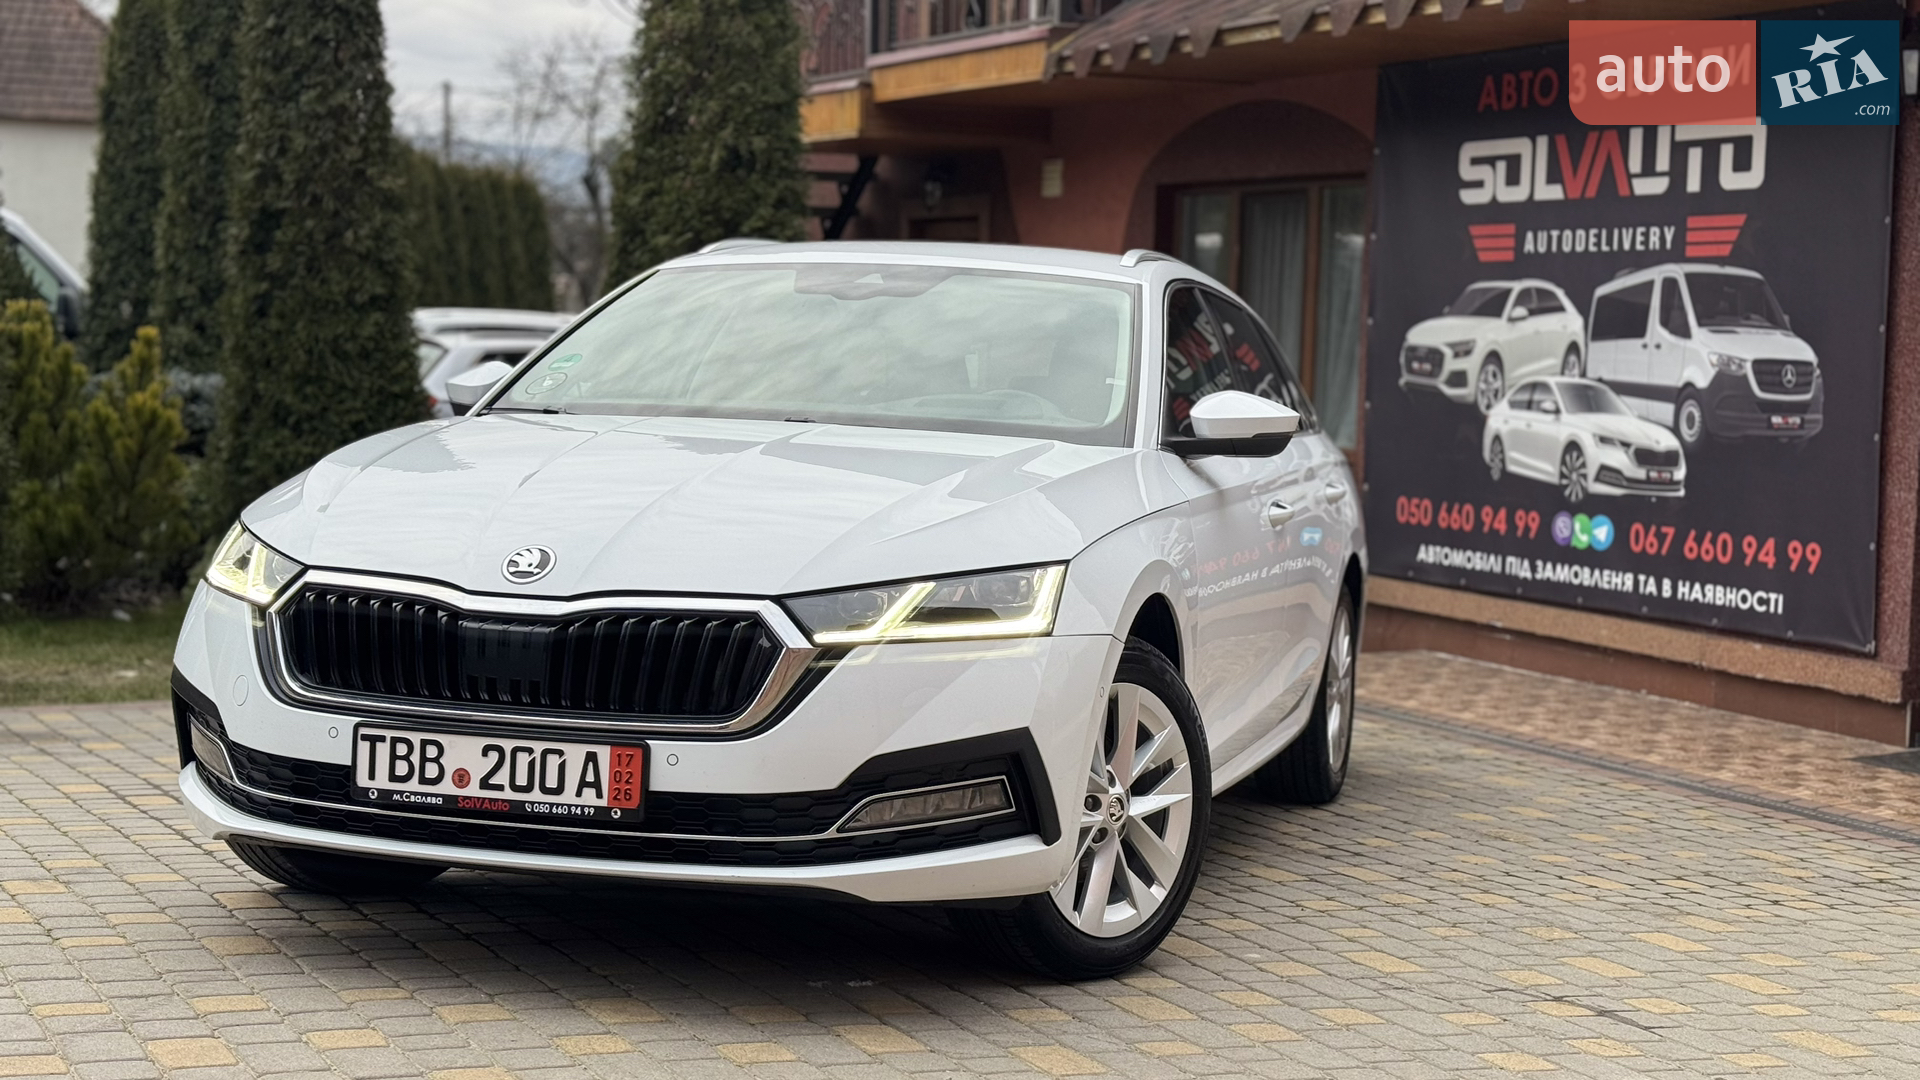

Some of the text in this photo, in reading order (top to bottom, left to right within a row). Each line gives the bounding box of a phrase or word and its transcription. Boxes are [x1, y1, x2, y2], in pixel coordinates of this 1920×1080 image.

[1478, 67, 1559, 112] АВТО
[1458, 116, 1767, 204] SOLVAUTO
[1523, 225, 1676, 254] AUTODELIVERY
[1396, 495, 1541, 539] 050 660 94 99
[1629, 522, 1822, 575] 067 660 94 99
[1416, 543, 1784, 615] АВТОМОБІЛІ ПІД ЗАМОВЛЕНЯ ТА В НАЯВНОСТІ
[360, 733, 603, 800] TBB 200 A
[613, 770, 633, 785] 02
[615, 752, 634, 767] 17
[533, 804, 595, 817] 050 660 94 99
[612, 786, 632, 801] 26
